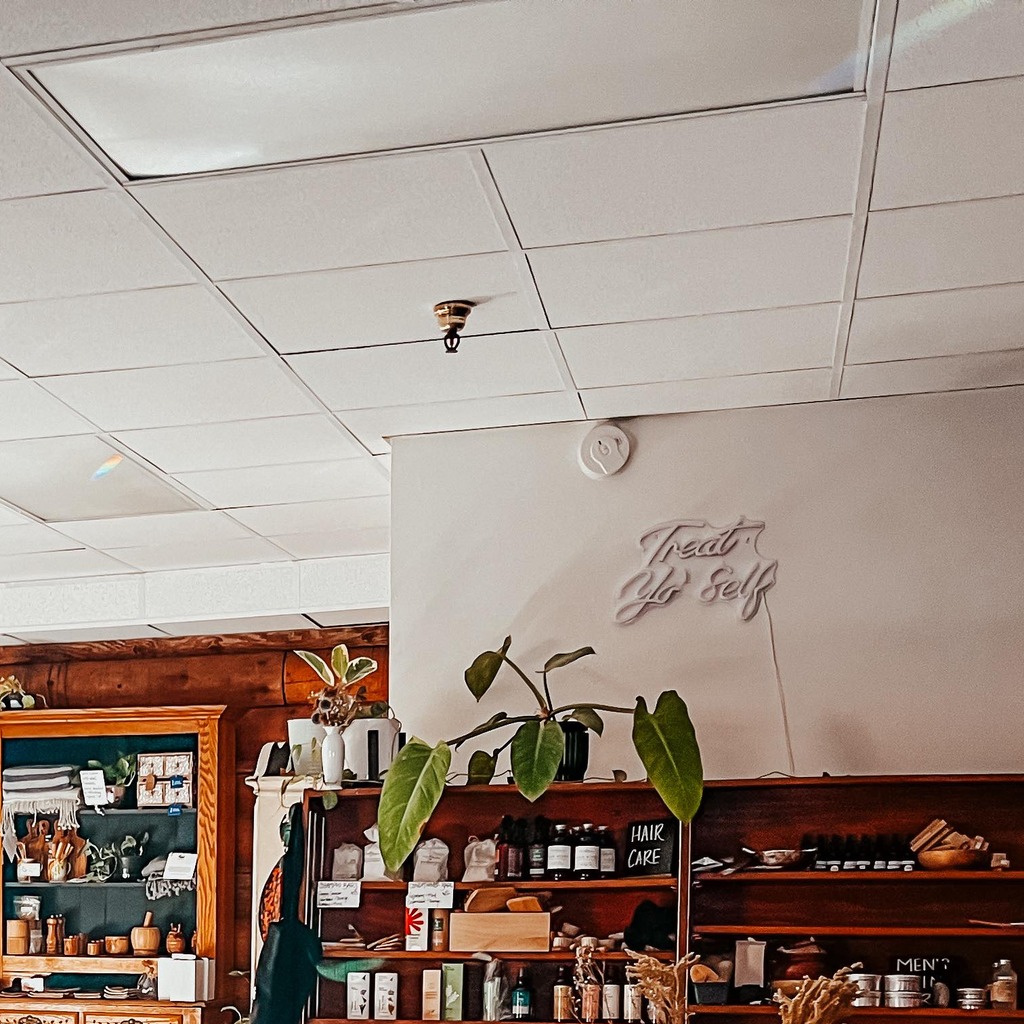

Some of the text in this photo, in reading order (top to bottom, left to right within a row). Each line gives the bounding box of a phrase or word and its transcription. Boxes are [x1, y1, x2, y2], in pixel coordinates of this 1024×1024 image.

[640, 517, 765, 566] Treat
[700, 560, 778, 622] Self
[630, 823, 665, 843] HAIR
[627, 848, 662, 869] CARE
